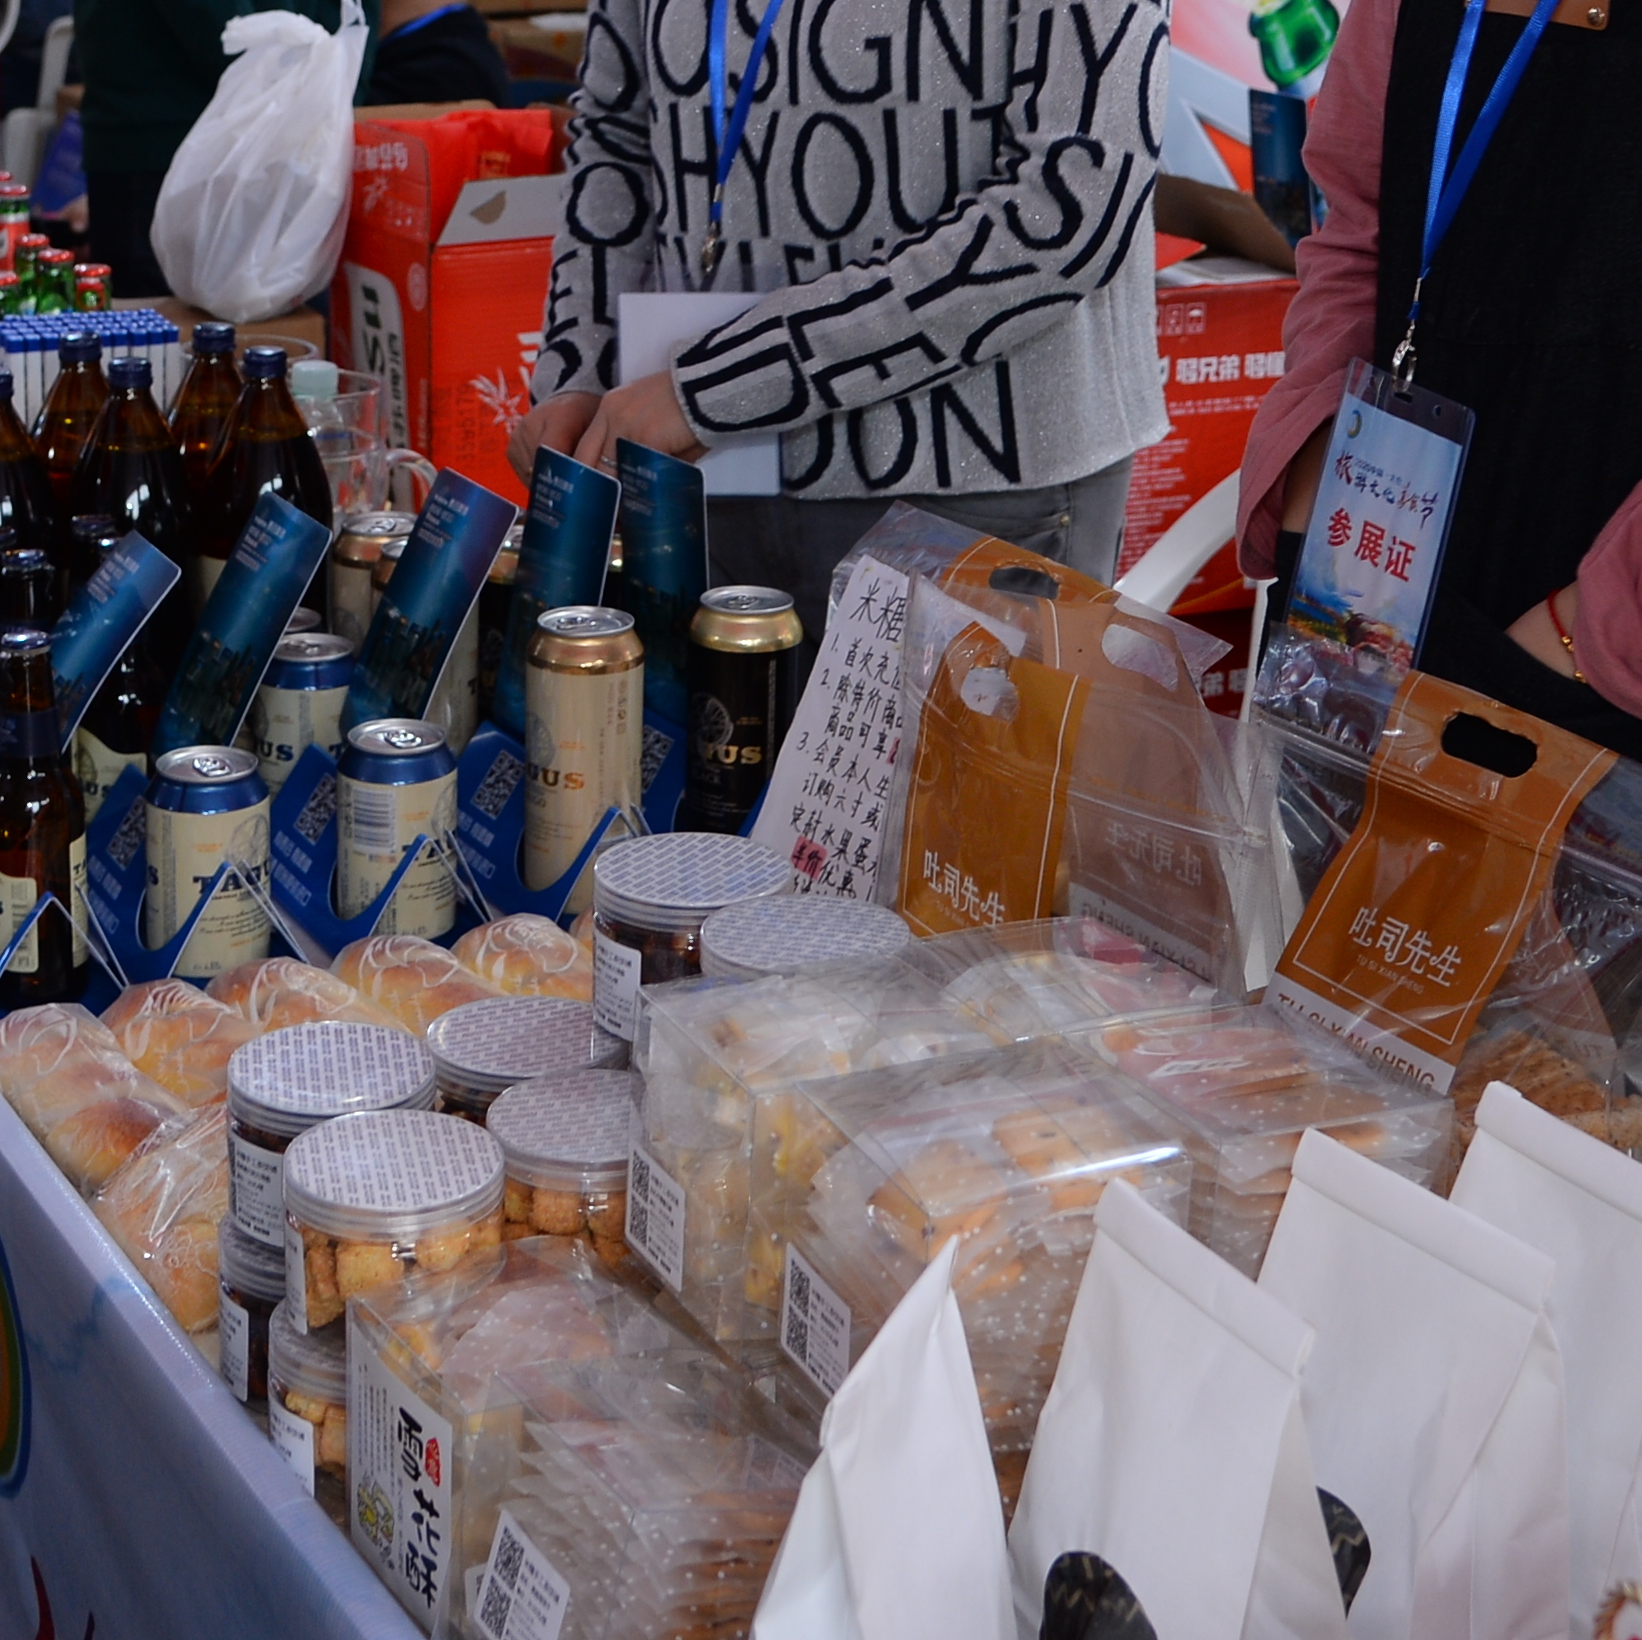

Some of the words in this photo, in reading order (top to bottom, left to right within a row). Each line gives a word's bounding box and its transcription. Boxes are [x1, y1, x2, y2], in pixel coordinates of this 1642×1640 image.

[1327, 507, 1417, 582] 参展证
[923, 849, 1006, 928] 吐司先生
[1348, 906, 1462, 988] 吐司先生
